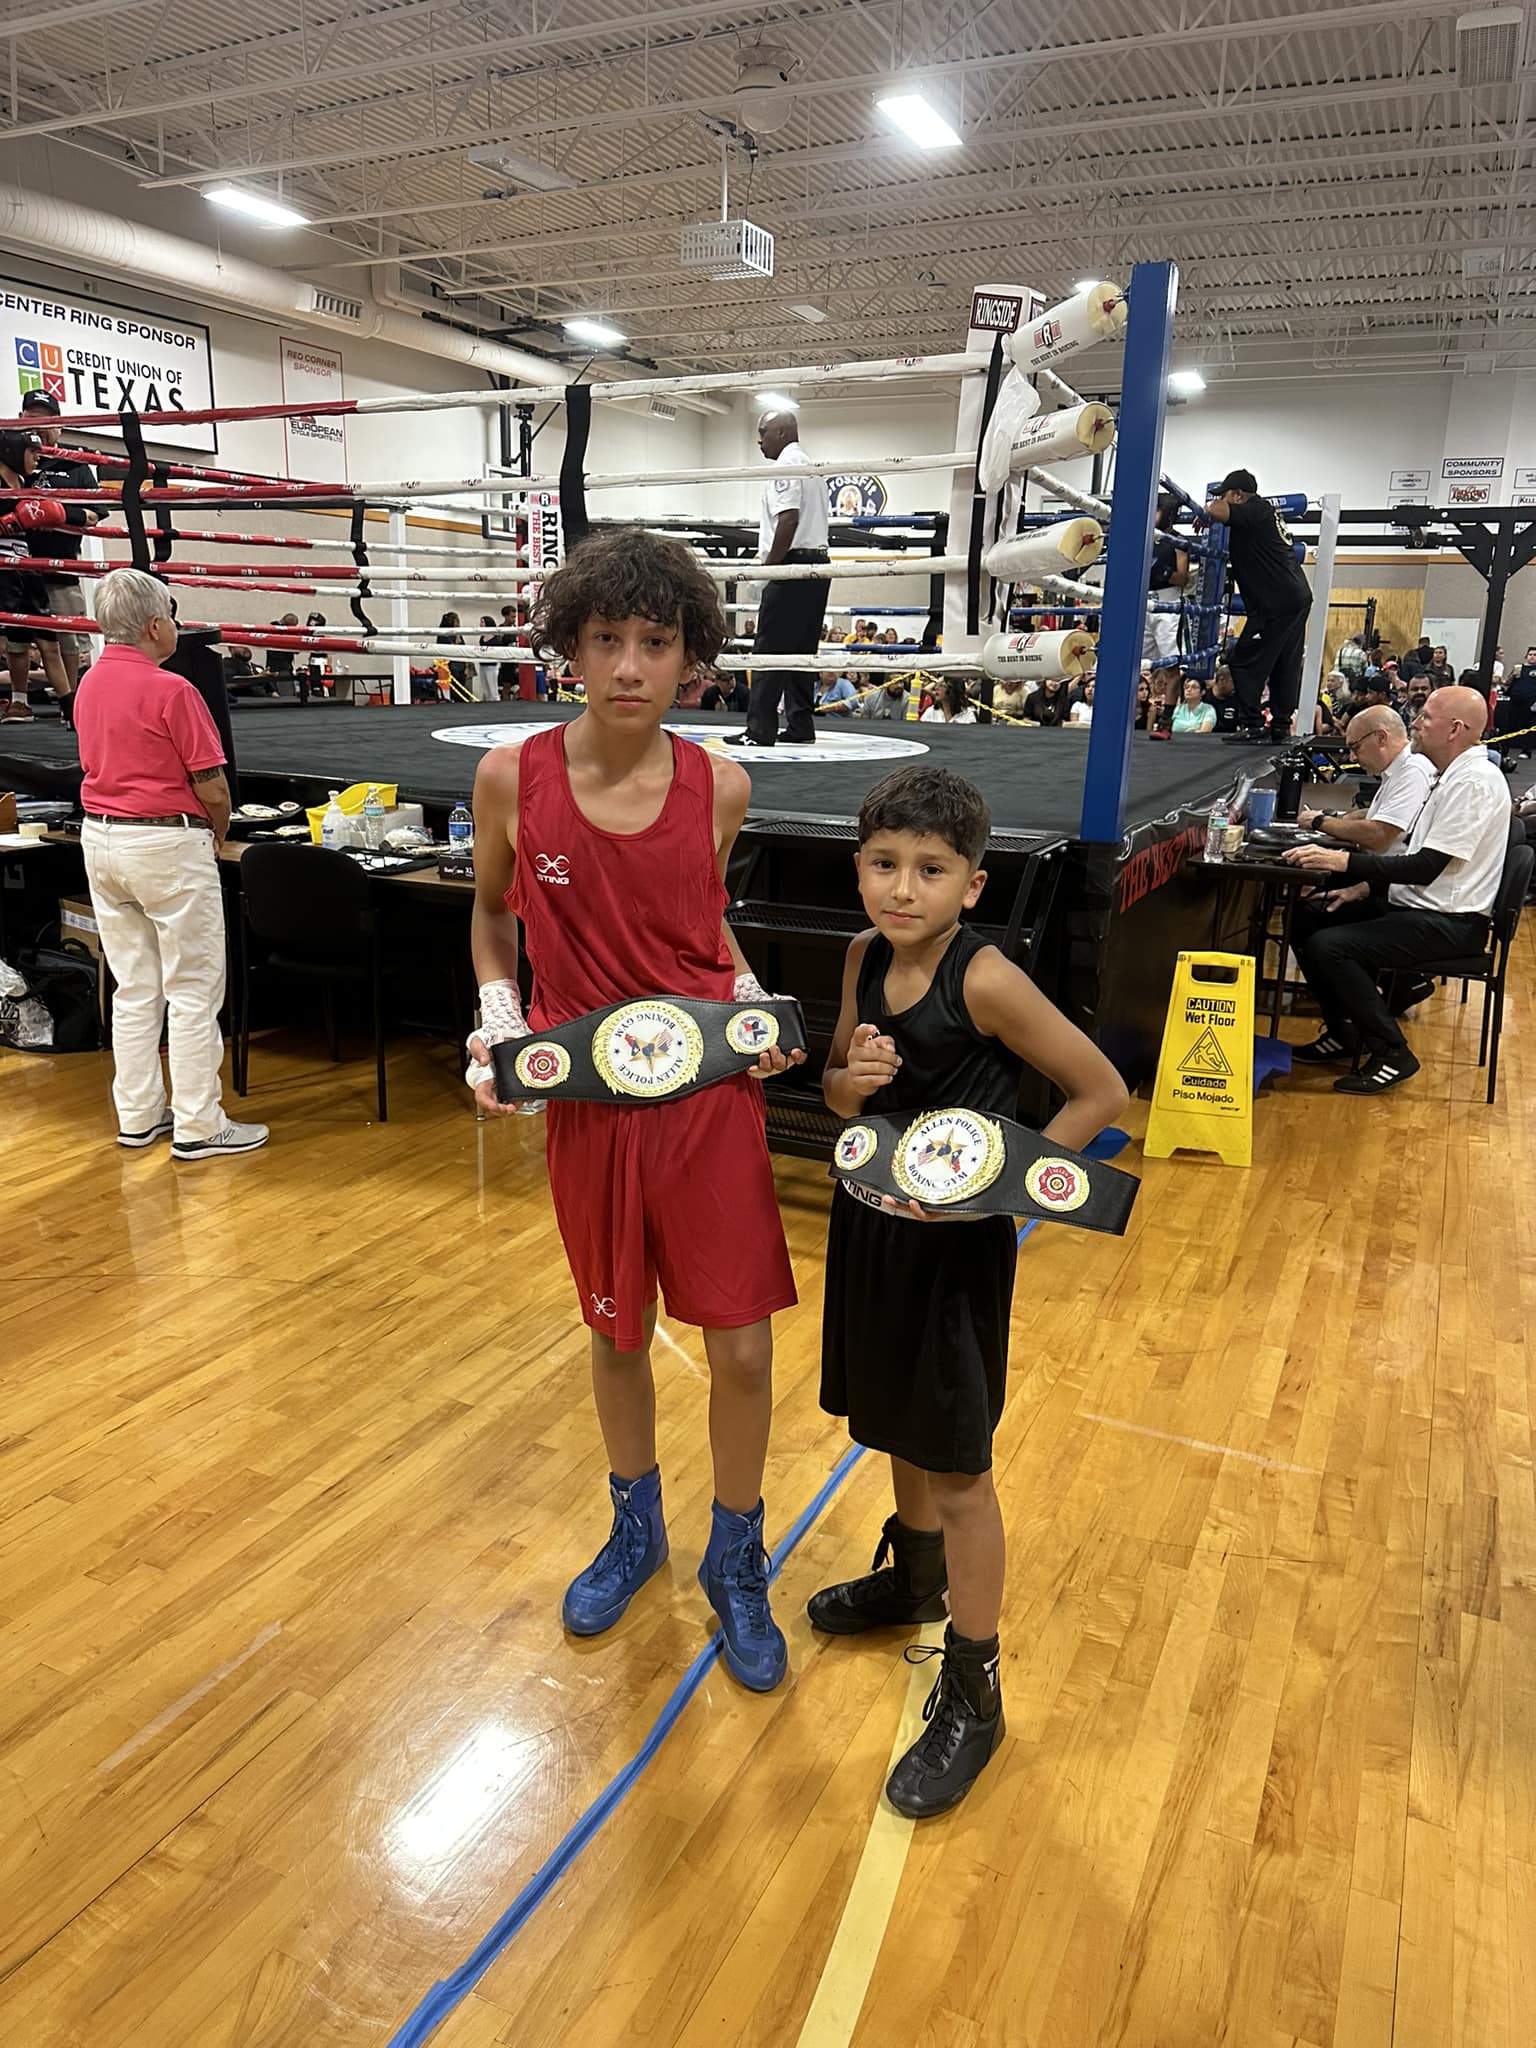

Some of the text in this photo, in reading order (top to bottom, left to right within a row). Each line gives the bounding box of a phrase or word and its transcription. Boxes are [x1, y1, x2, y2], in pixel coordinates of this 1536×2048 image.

[975, 297, 1018, 328] RINGSIDE
[70, 309, 113, 331] RING
[116, 320, 197, 350] SPONSOR
[66, 349, 183, 385] CREDIT UNION OF
[287, 350, 338, 369] RED CORNER
[293, 362, 332, 378] SPONSOR
[67, 367, 185, 413] TEXAS
[290, 420, 343, 438] EUROPEAN
[291, 429, 310, 438] CYCLE
[311, 432, 333, 441] SPORTS
[1446, 460, 1502, 468] COMMUNITY
[532, 510, 541, 565] THE BEST
[536, 873, 570, 885] STING
[1120, 847, 1150, 913] THE
[1151, 830, 1187, 890] BEST
[1186, 998, 1235, 1013] CAUTION
[615, 1012, 677, 1038] BOXING GYM
[1184, 1011, 1236, 1027] Wet Floor
[617, 1056, 684, 1085] ALLEN POLICE
[1183, 1076, 1226, 1089] Cuidado
[1172, 1089, 1234, 1103] Piso Mojado
[920, 1117, 983, 1146] ALLEN POLICE
[845, 1178, 882, 1208] TING
